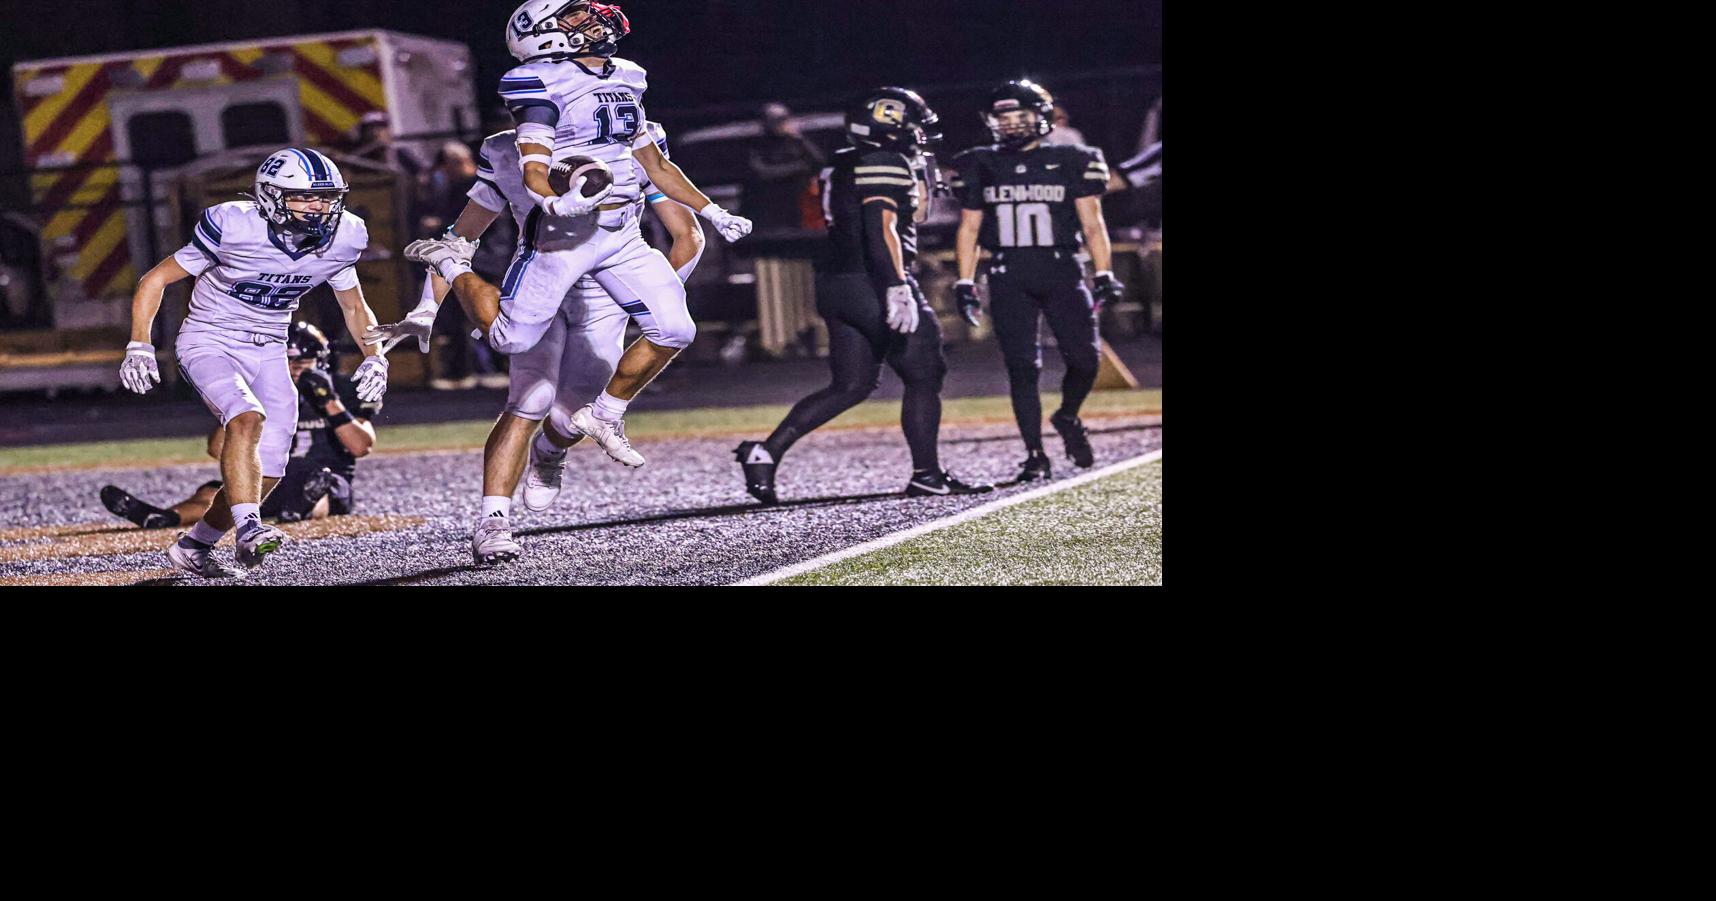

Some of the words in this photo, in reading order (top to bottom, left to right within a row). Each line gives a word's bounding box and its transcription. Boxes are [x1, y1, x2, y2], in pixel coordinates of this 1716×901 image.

[512, 9, 535, 39] 13
[592, 92, 635, 103] TITANS
[593, 103, 641, 144] 13
[259, 156, 287, 179] 82
[983, 184, 1065, 203] GLENWOOD
[996, 203, 1054, 247] 10
[257, 272, 313, 284] TITANS
[229, 280, 314, 312] 82
